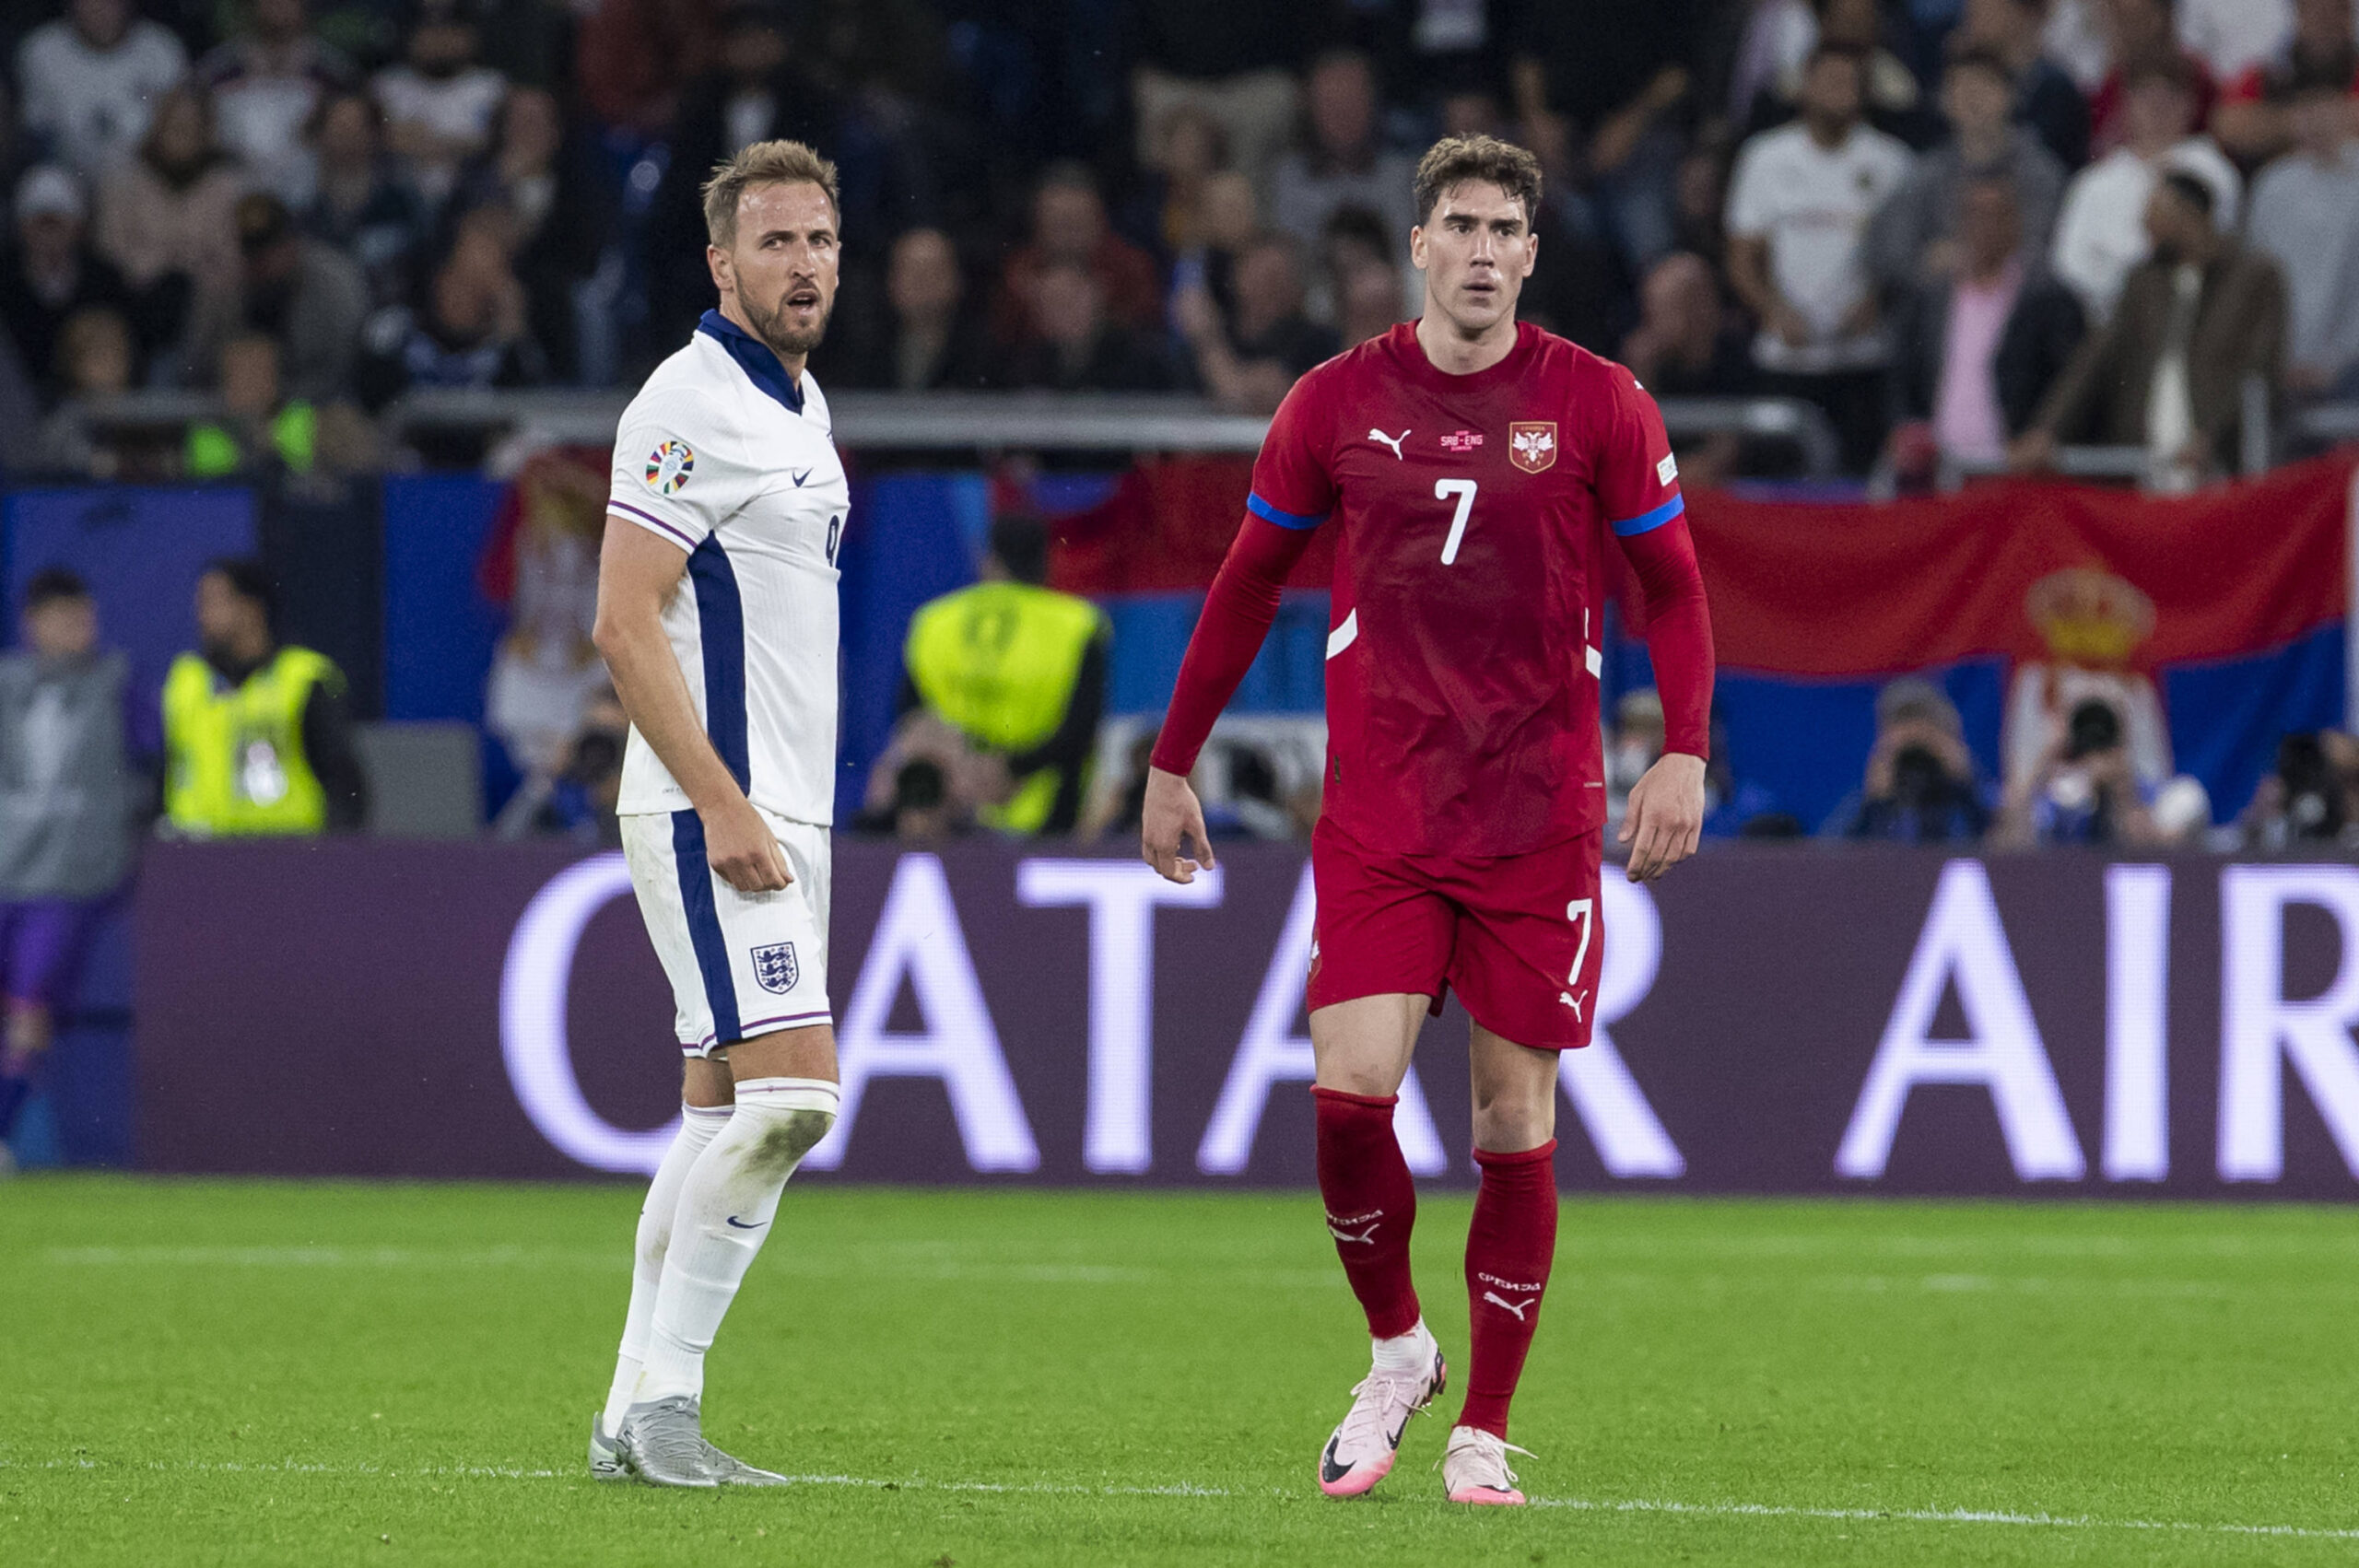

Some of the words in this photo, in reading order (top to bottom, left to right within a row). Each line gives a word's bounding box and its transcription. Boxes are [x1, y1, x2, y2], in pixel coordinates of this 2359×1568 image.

[1435, 478, 1477, 565] 7
[1567, 897, 1592, 986] 7
[1834, 859, 2359, 1182] AIR
